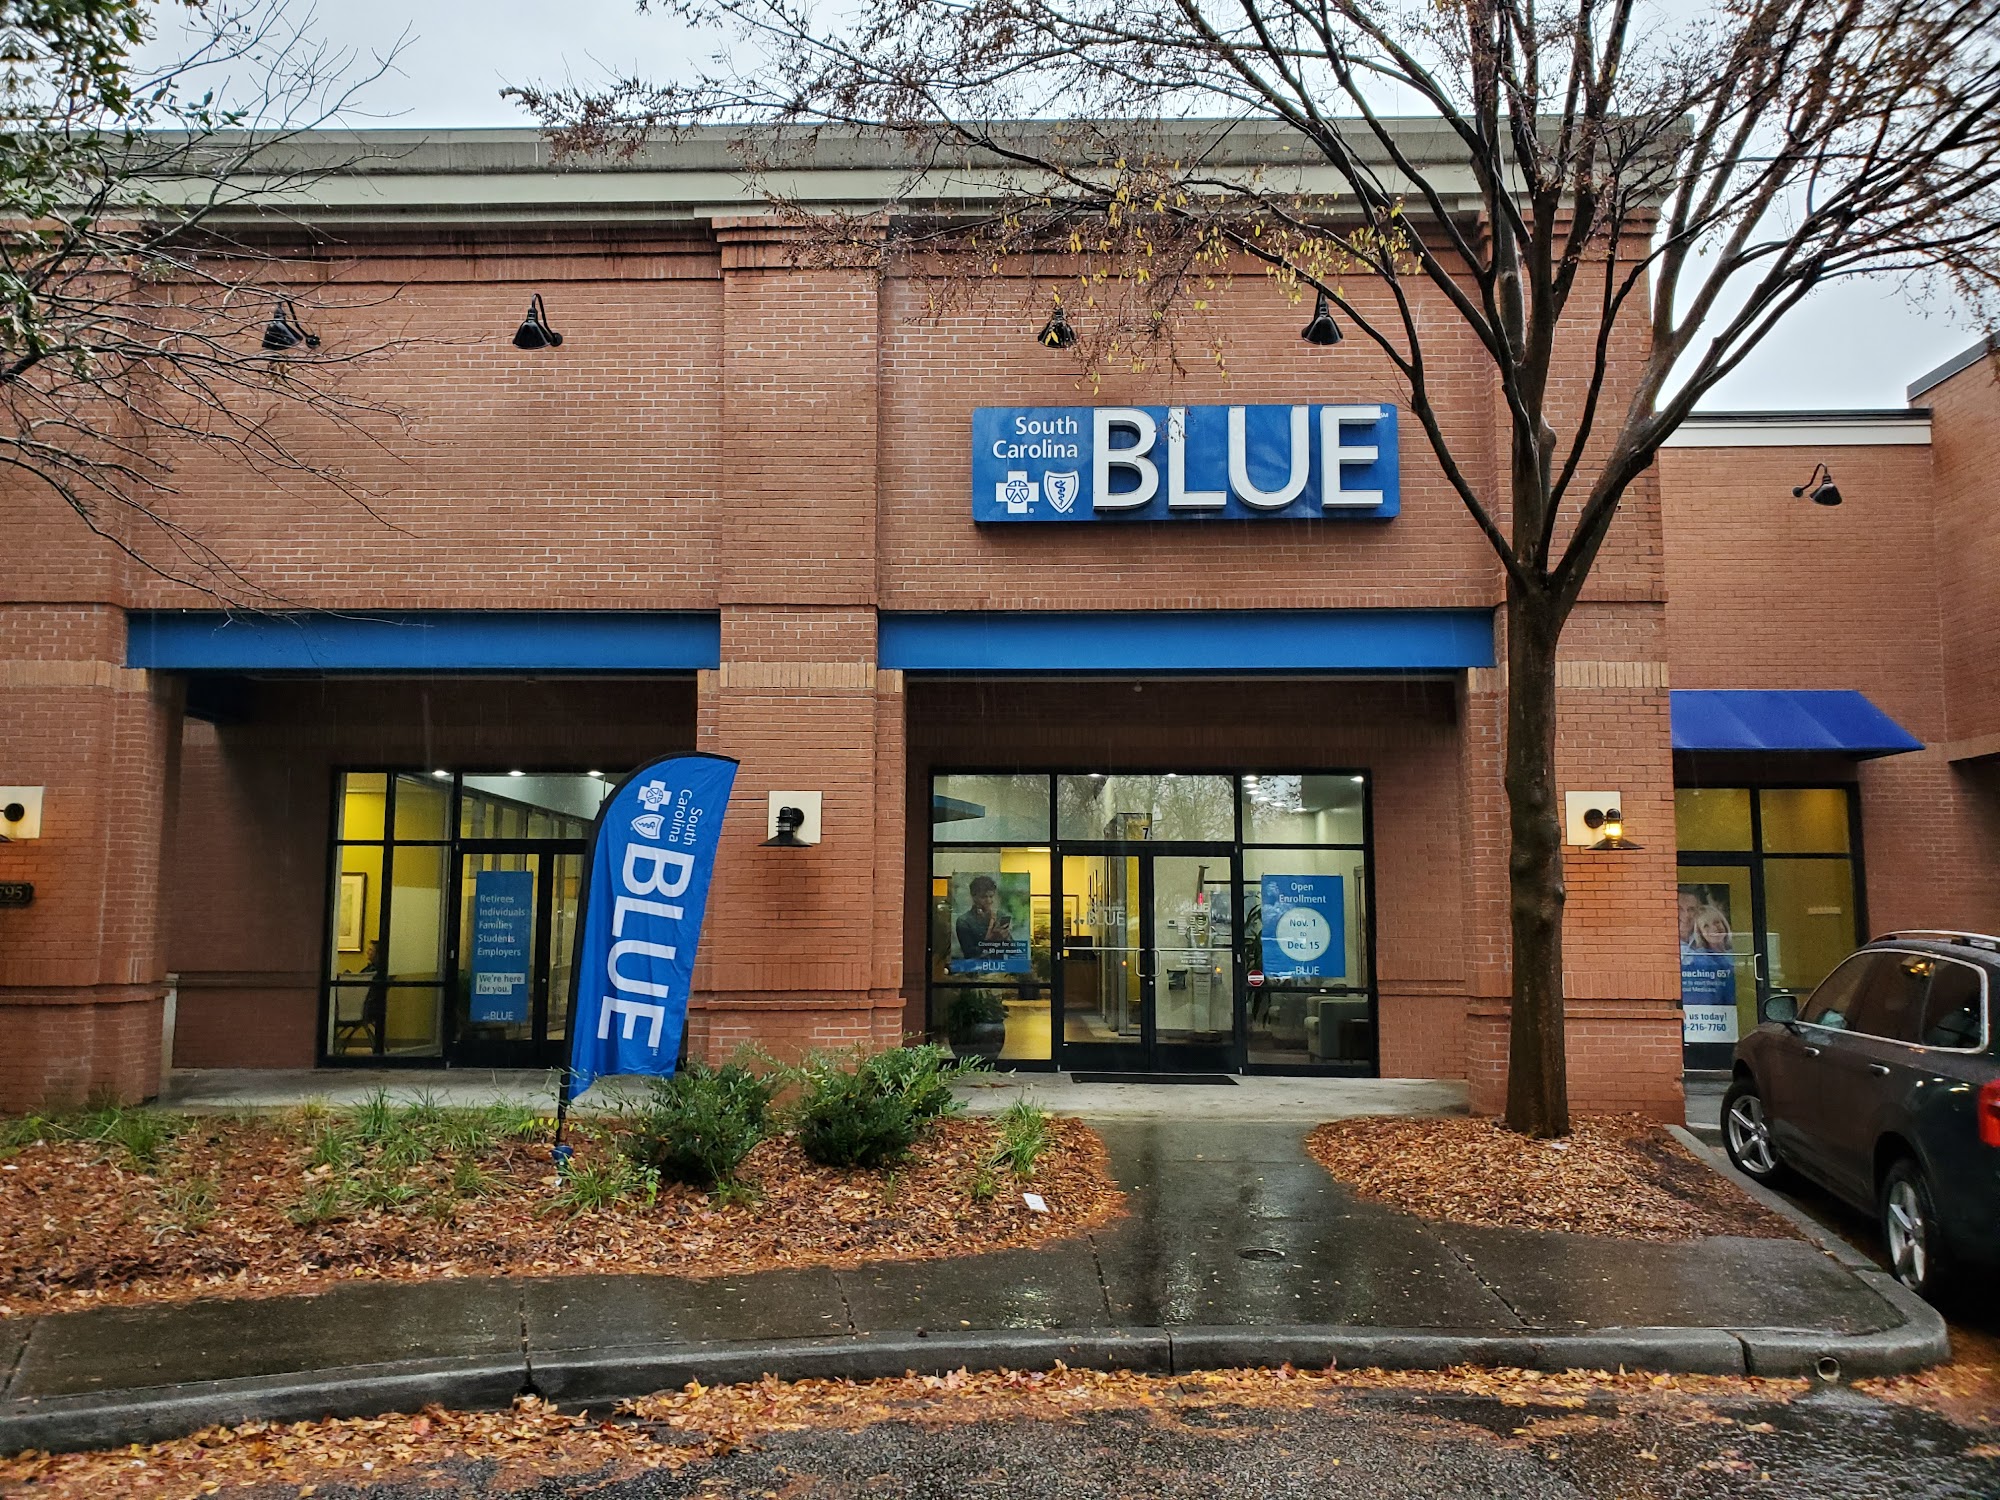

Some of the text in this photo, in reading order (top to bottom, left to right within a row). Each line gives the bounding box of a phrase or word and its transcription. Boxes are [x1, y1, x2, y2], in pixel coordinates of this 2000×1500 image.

[1015, 416, 1078, 436] South
[992, 440, 1079, 460] Carolina
[1093, 405, 1384, 511] BLUE
[668, 789, 694, 843] Carolina
[682, 806, 704, 846] South
[1290, 882, 1314, 893] Open
[480, 895, 514, 903] Retirees
[1279, 894, 1327, 903] Enrollment
[479, 907, 525, 917] Individuals
[478, 920, 513, 930] Families
[1289, 919, 1316, 927] Nov. 1
[478, 934, 515, 943] Students
[597, 842, 696, 1049] BLUE
[1309, 941, 1320, 950] 15
[477, 948, 521, 958] Employers
[982, 961, 1007, 971] BLUE
[1295, 965, 1320, 975] BLUE
[479, 974, 522, 983] We're here
[478, 984, 510, 995] for you.
[490, 1010, 514, 1021] BLUE
[1701, 1012, 1728, 1022] today!
